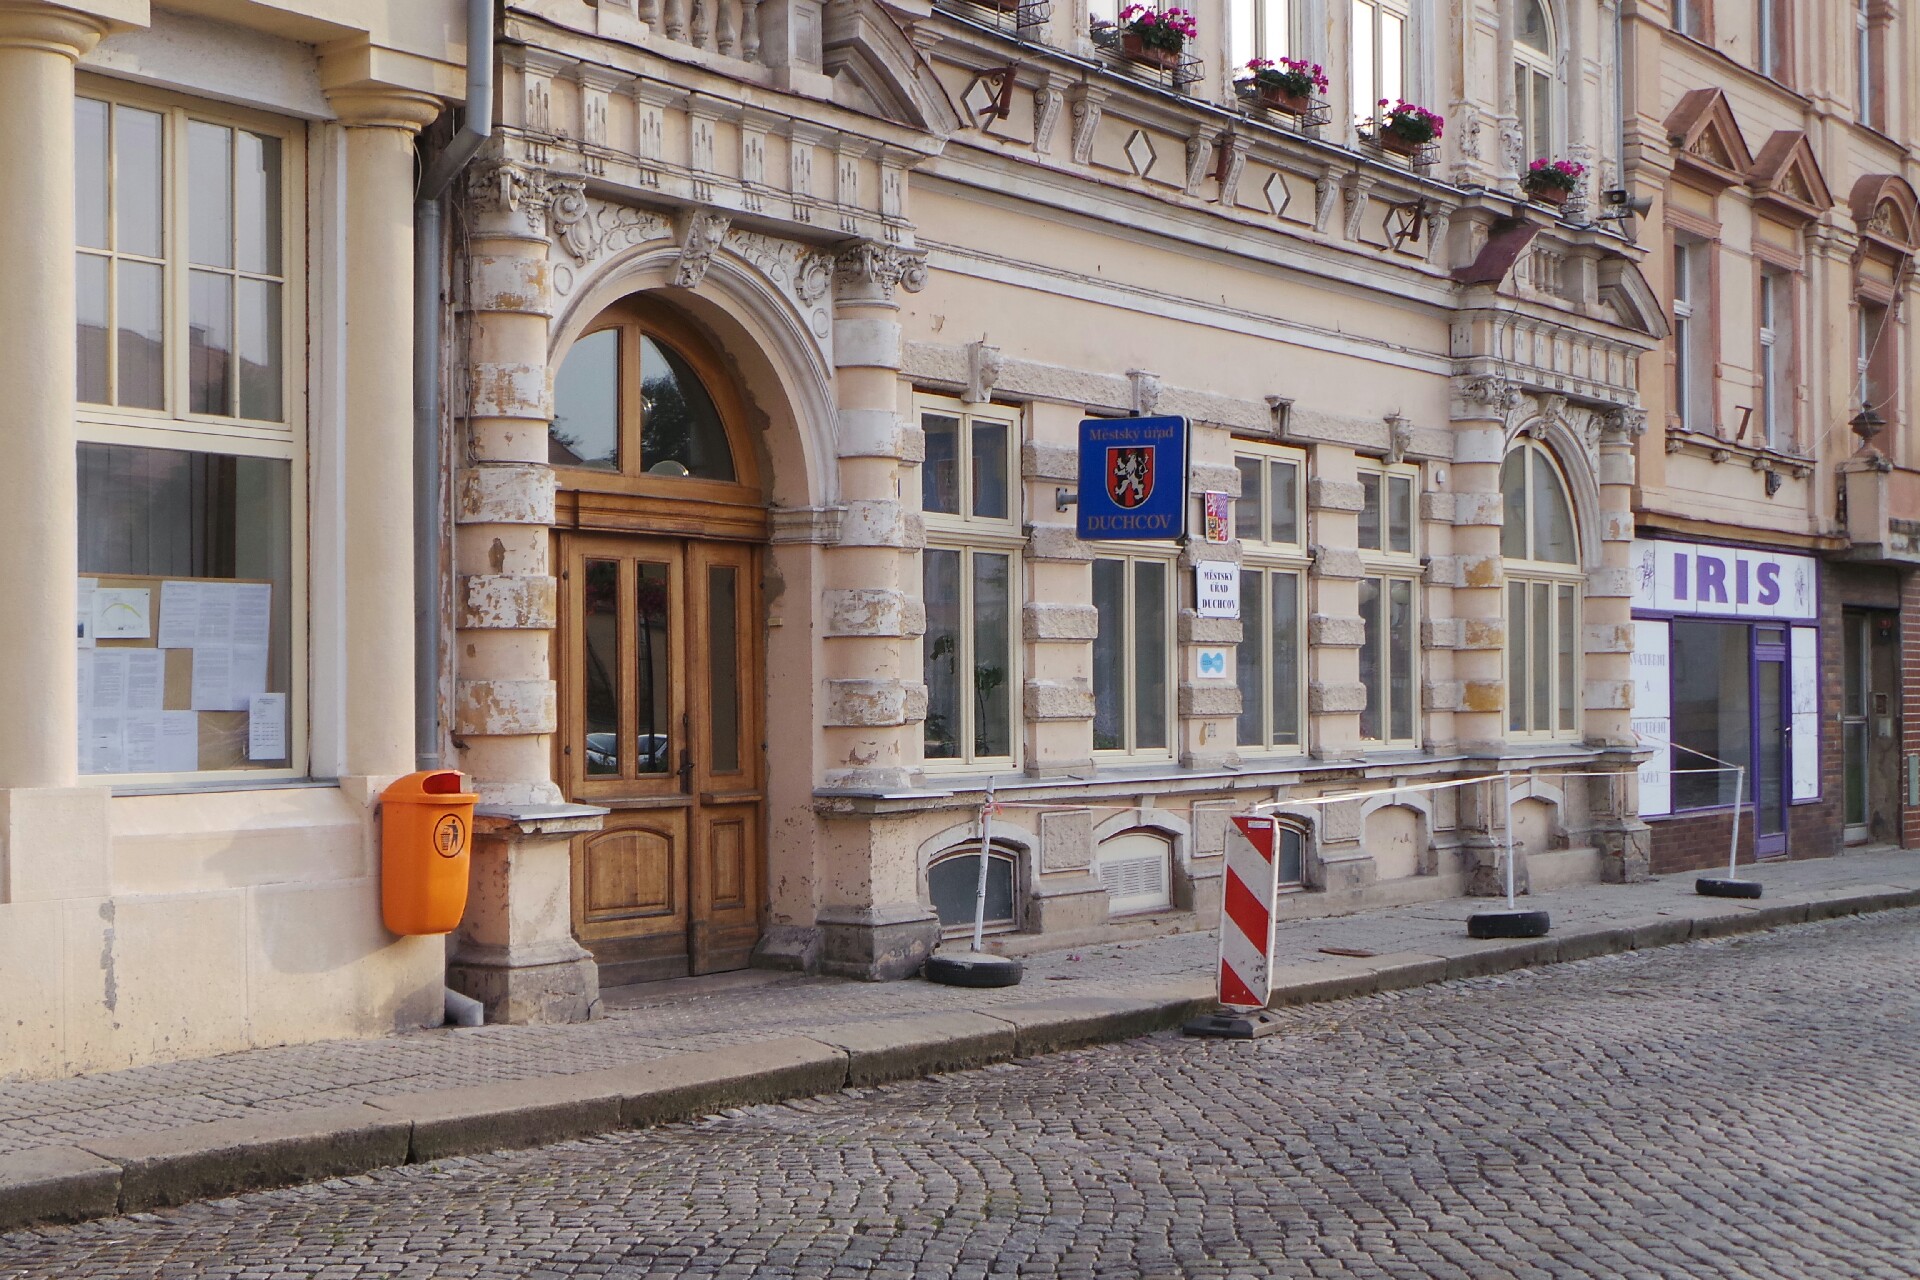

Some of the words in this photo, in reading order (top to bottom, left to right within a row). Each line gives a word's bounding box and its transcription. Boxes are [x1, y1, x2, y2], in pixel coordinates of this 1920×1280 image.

[1090, 427, 1140, 442] Městský
[1144, 425, 1174, 439] úřad
[1087, 514, 1172, 531] DUCHCOV
[1203, 569, 1233, 581] MĚSTSKÝ
[1673, 552, 1781, 606] IRIS
[1210, 582, 1229, 593] ÚŘAD
[1202, 598, 1236, 609] DUCHCOV
